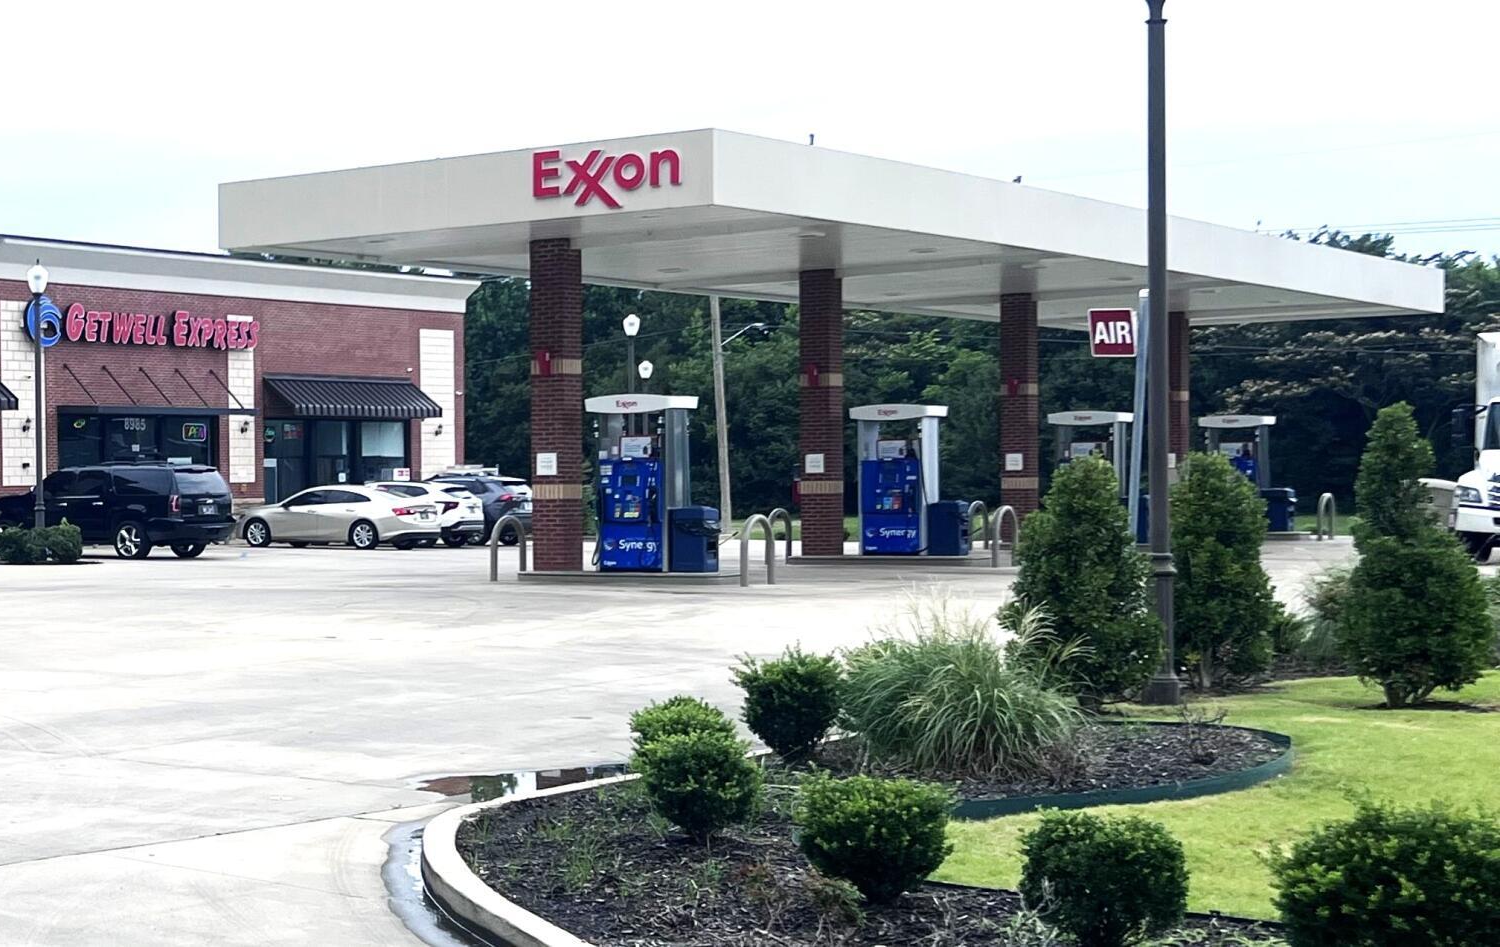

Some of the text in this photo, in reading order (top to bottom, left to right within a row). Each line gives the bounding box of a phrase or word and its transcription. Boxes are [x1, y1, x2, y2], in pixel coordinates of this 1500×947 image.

[532, 148, 683, 209] Exxon
[66, 302, 261, 350] GETWELL EXPRESS
[1094, 321, 1132, 344] AIR
[615, 400, 638, 409] Exxon
[124, 417, 146, 431] 8985
[618, 539, 657, 552] Synegy
